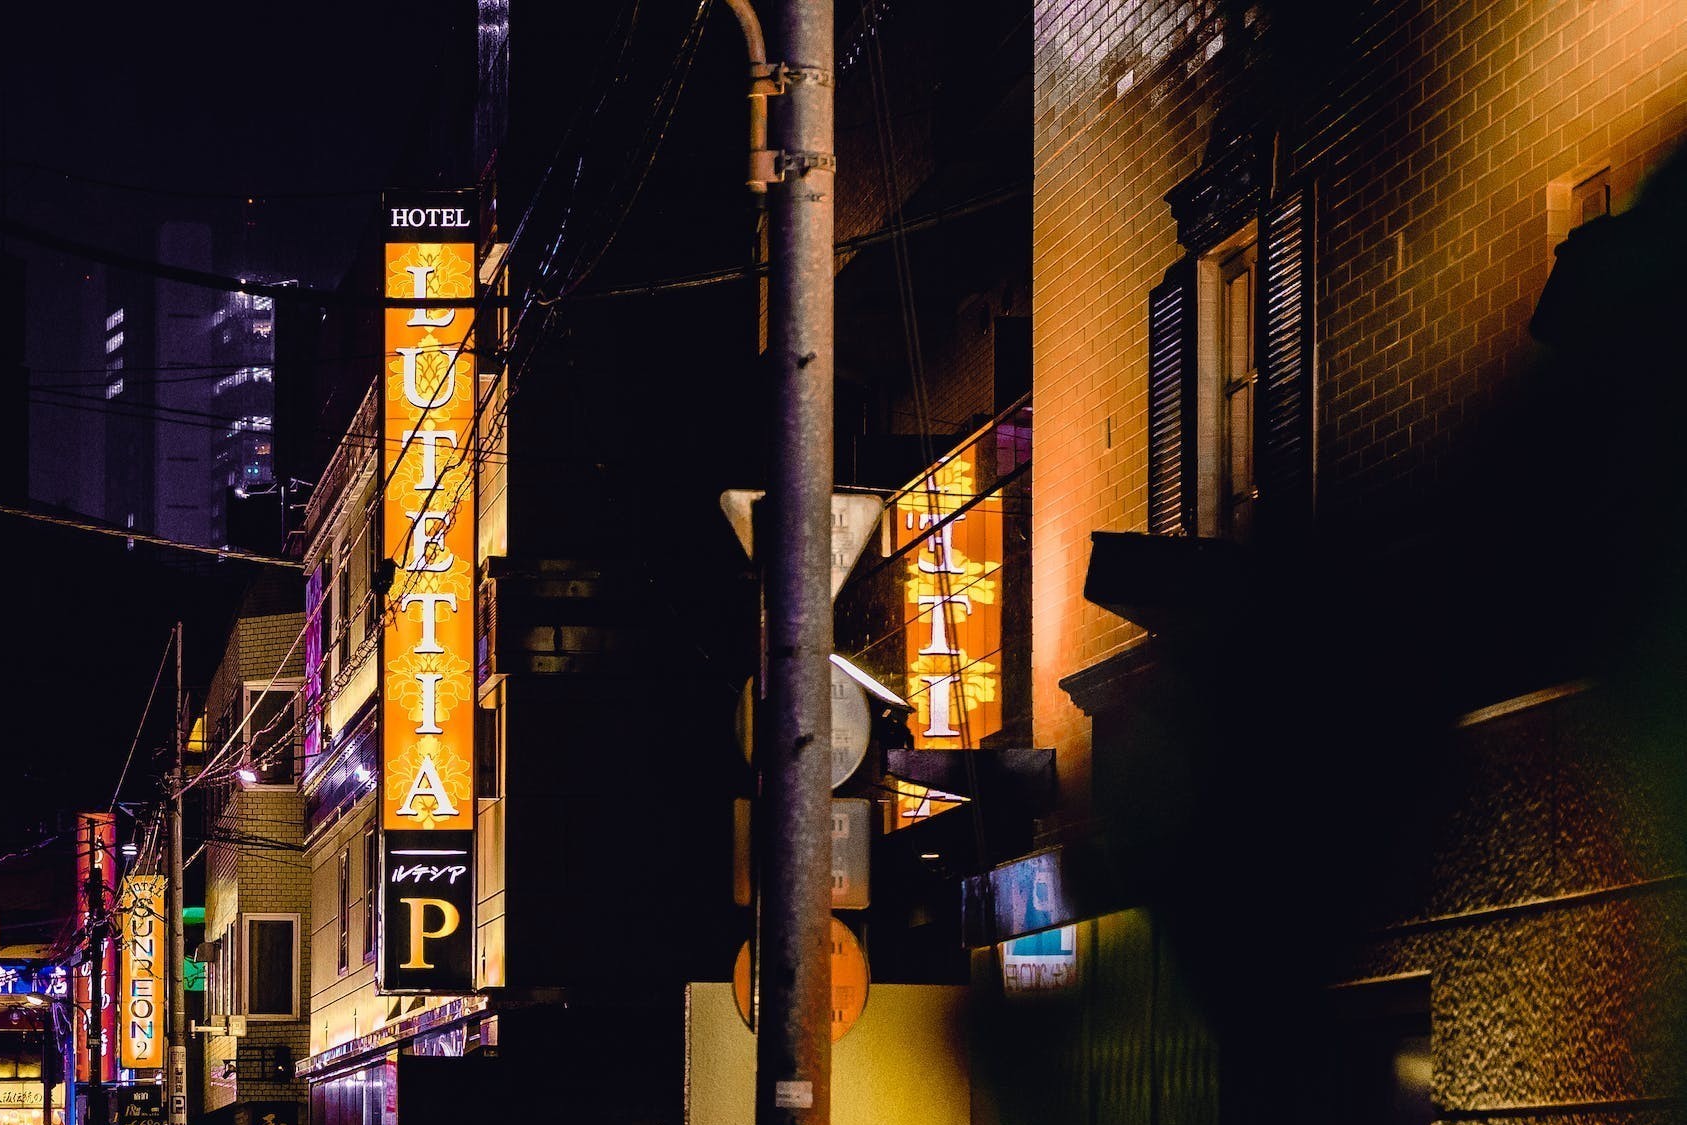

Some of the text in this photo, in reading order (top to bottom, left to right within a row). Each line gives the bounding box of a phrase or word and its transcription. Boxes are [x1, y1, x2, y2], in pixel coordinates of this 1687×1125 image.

[390, 208, 470, 228] HOTEL
[395, 265, 460, 817] LUTETIA
[392, 864, 467, 884] ルテシア
[399, 897, 460, 969] P
